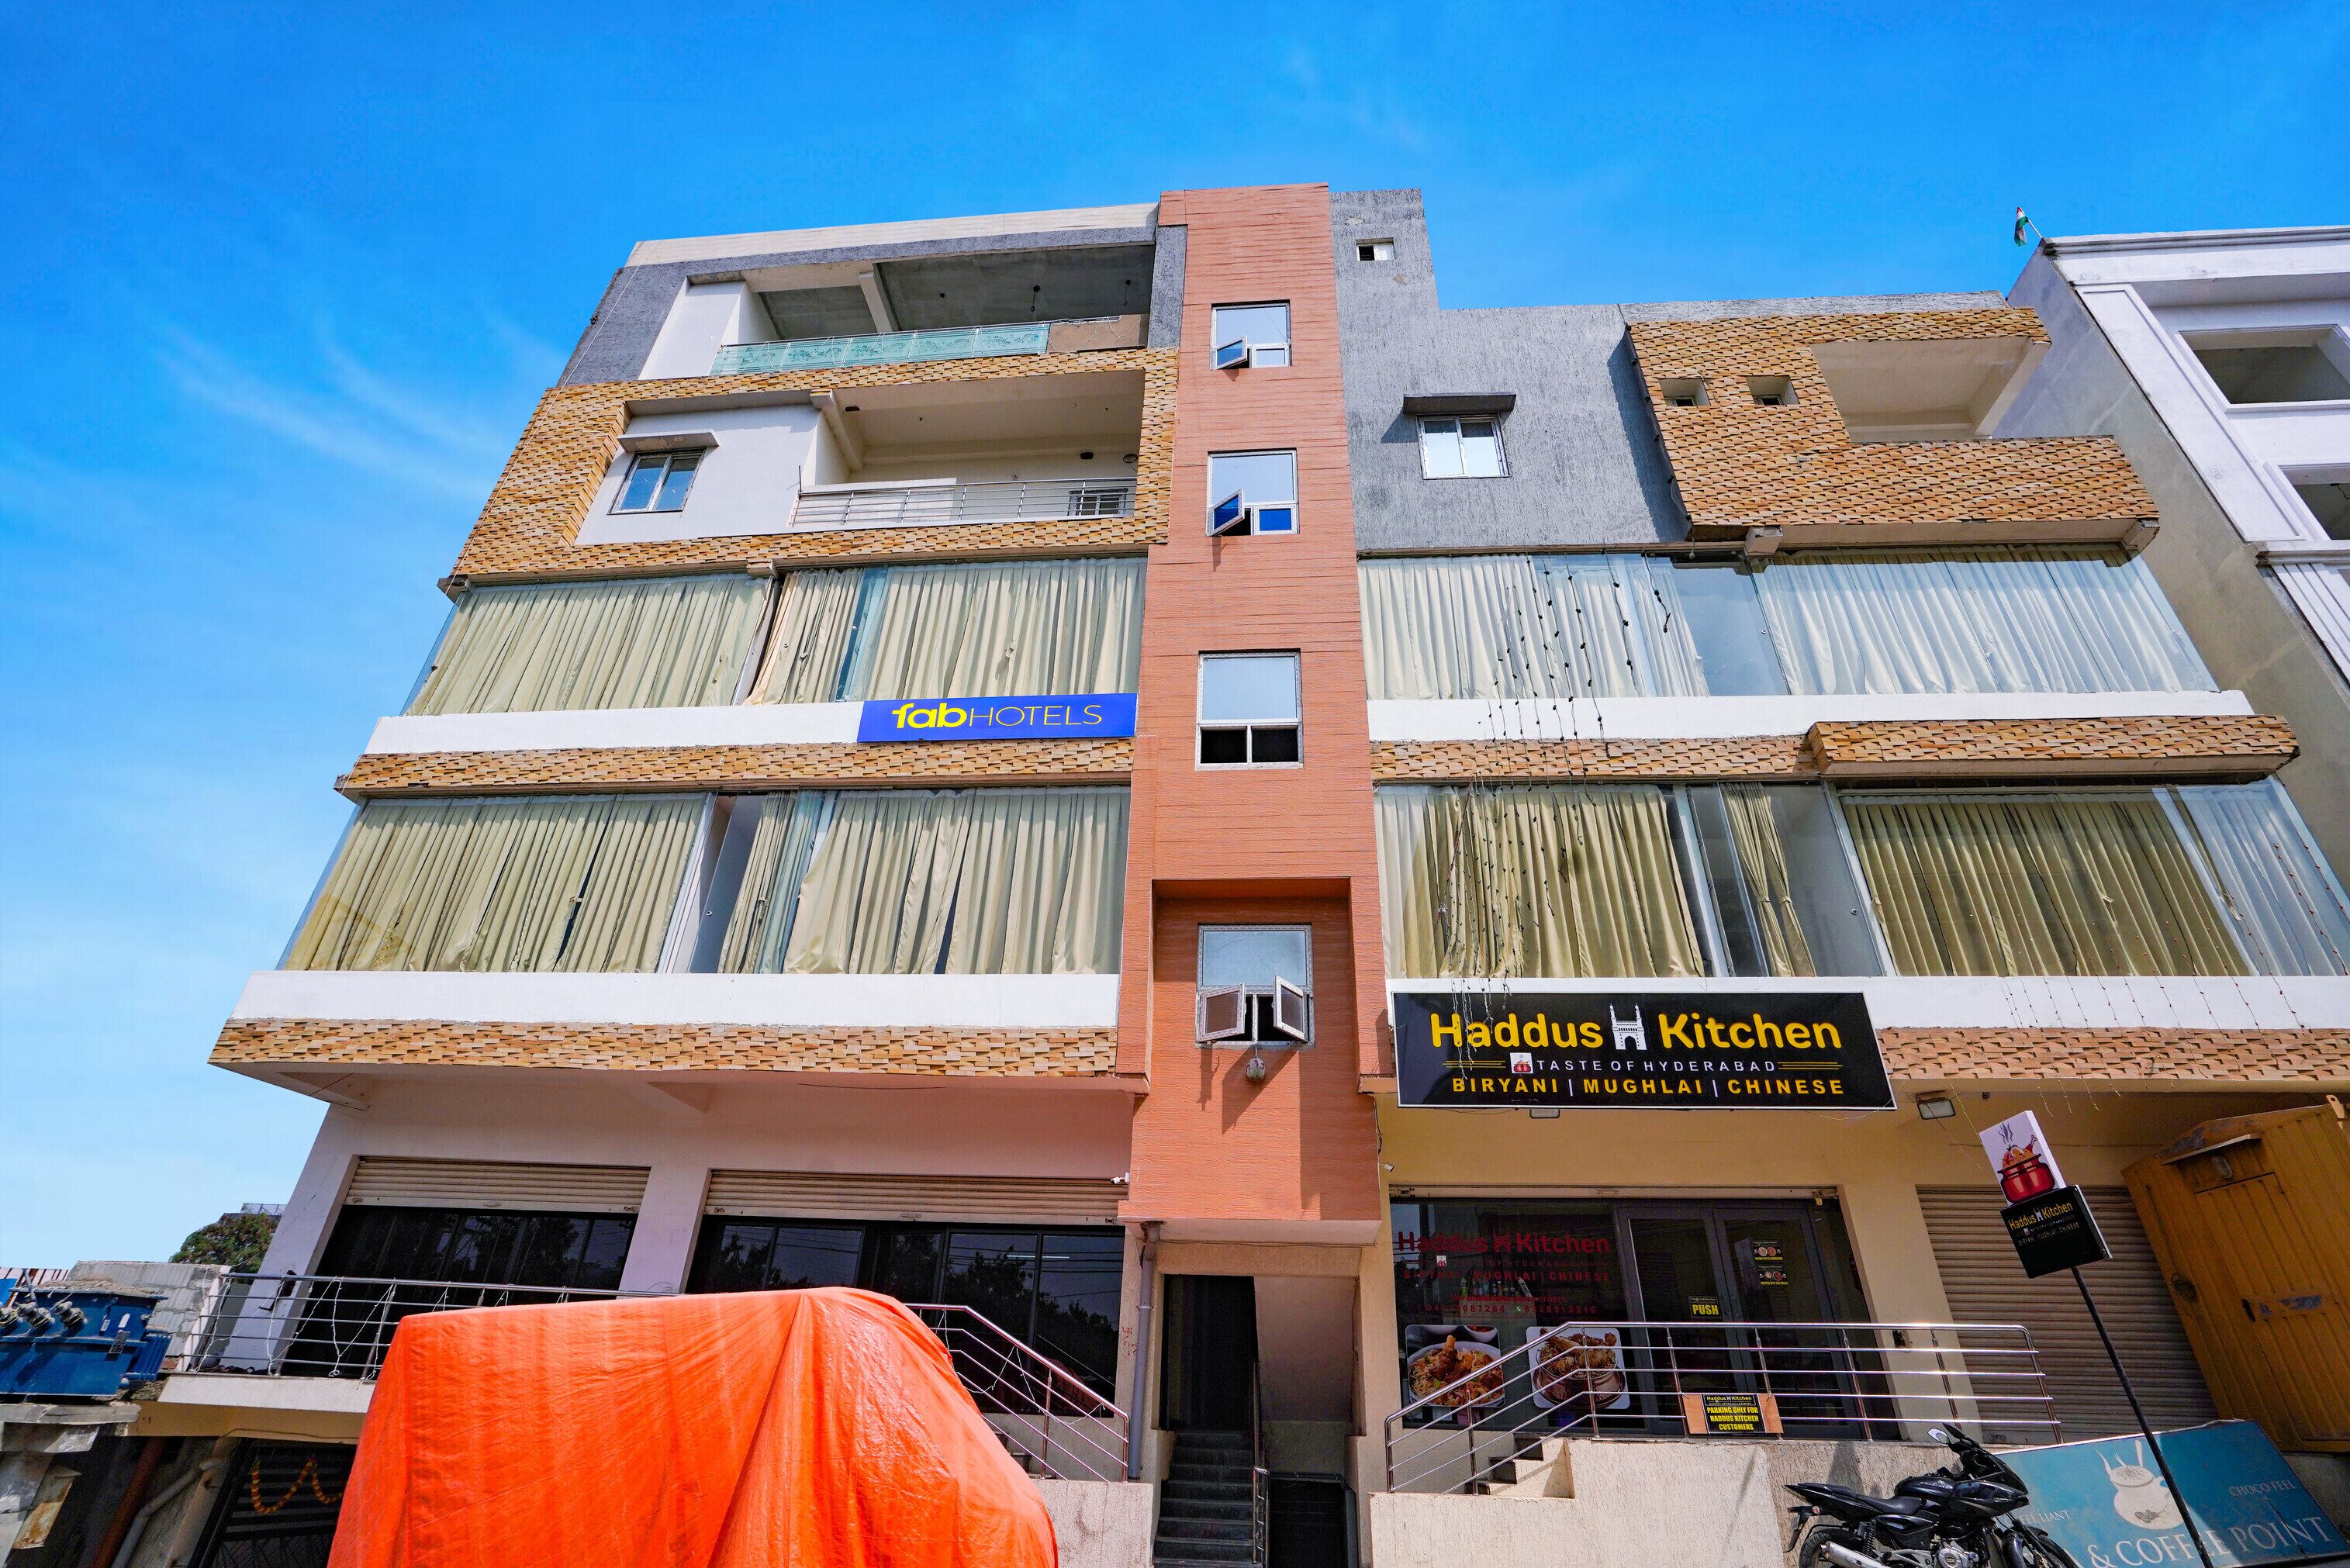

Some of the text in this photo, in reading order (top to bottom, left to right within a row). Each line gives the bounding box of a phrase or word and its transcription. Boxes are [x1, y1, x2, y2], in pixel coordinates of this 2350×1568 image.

[1430, 1012, 1842, 1049] Haddus Kitchen
[1536, 1060, 1775, 1072] TASTE OF HYDERABAD
[1452, 1078, 1844, 1094] BIRYANI MUGHLAI CHINESE
[2009, 1214, 2037, 1230] Haddus
[2041, 1203, 2073, 1219] Kitchen
[1398, 1231, 1610, 1253] Haddus Kitchen
[1692, 1304, 1719, 1315] PUSH
[2229, 1480, 2297, 1497] CHOCO FEEL
[2004, 1510, 2072, 1526] CFFEE LIANT
[2227, 1516, 2333, 1552] POINT
